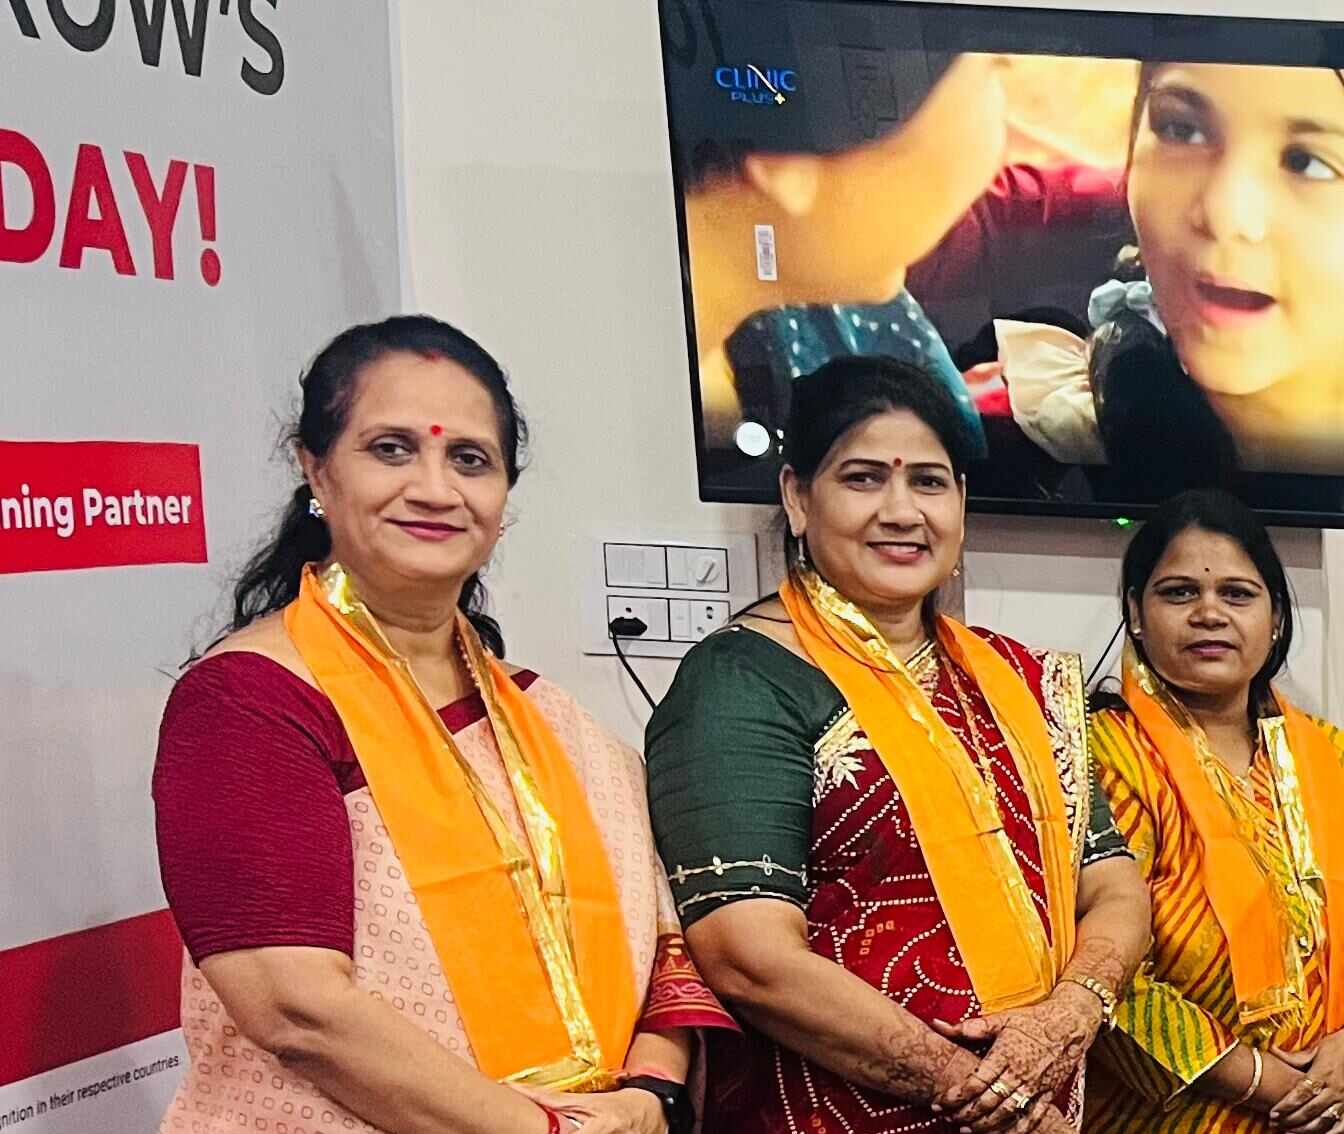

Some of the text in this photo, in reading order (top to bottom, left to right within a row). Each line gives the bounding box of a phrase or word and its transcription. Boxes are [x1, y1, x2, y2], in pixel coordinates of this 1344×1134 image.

[715, 65, 798, 92] CLINIC
[0, 128, 221, 287] DAY!
[83, 488, 191, 527] Partner
[36, 1100, 48, 1115] in
[50, 1089, 74, 1110] their
[77, 1070, 131, 1101] respective
[133, 1055, 179, 1081] countries
